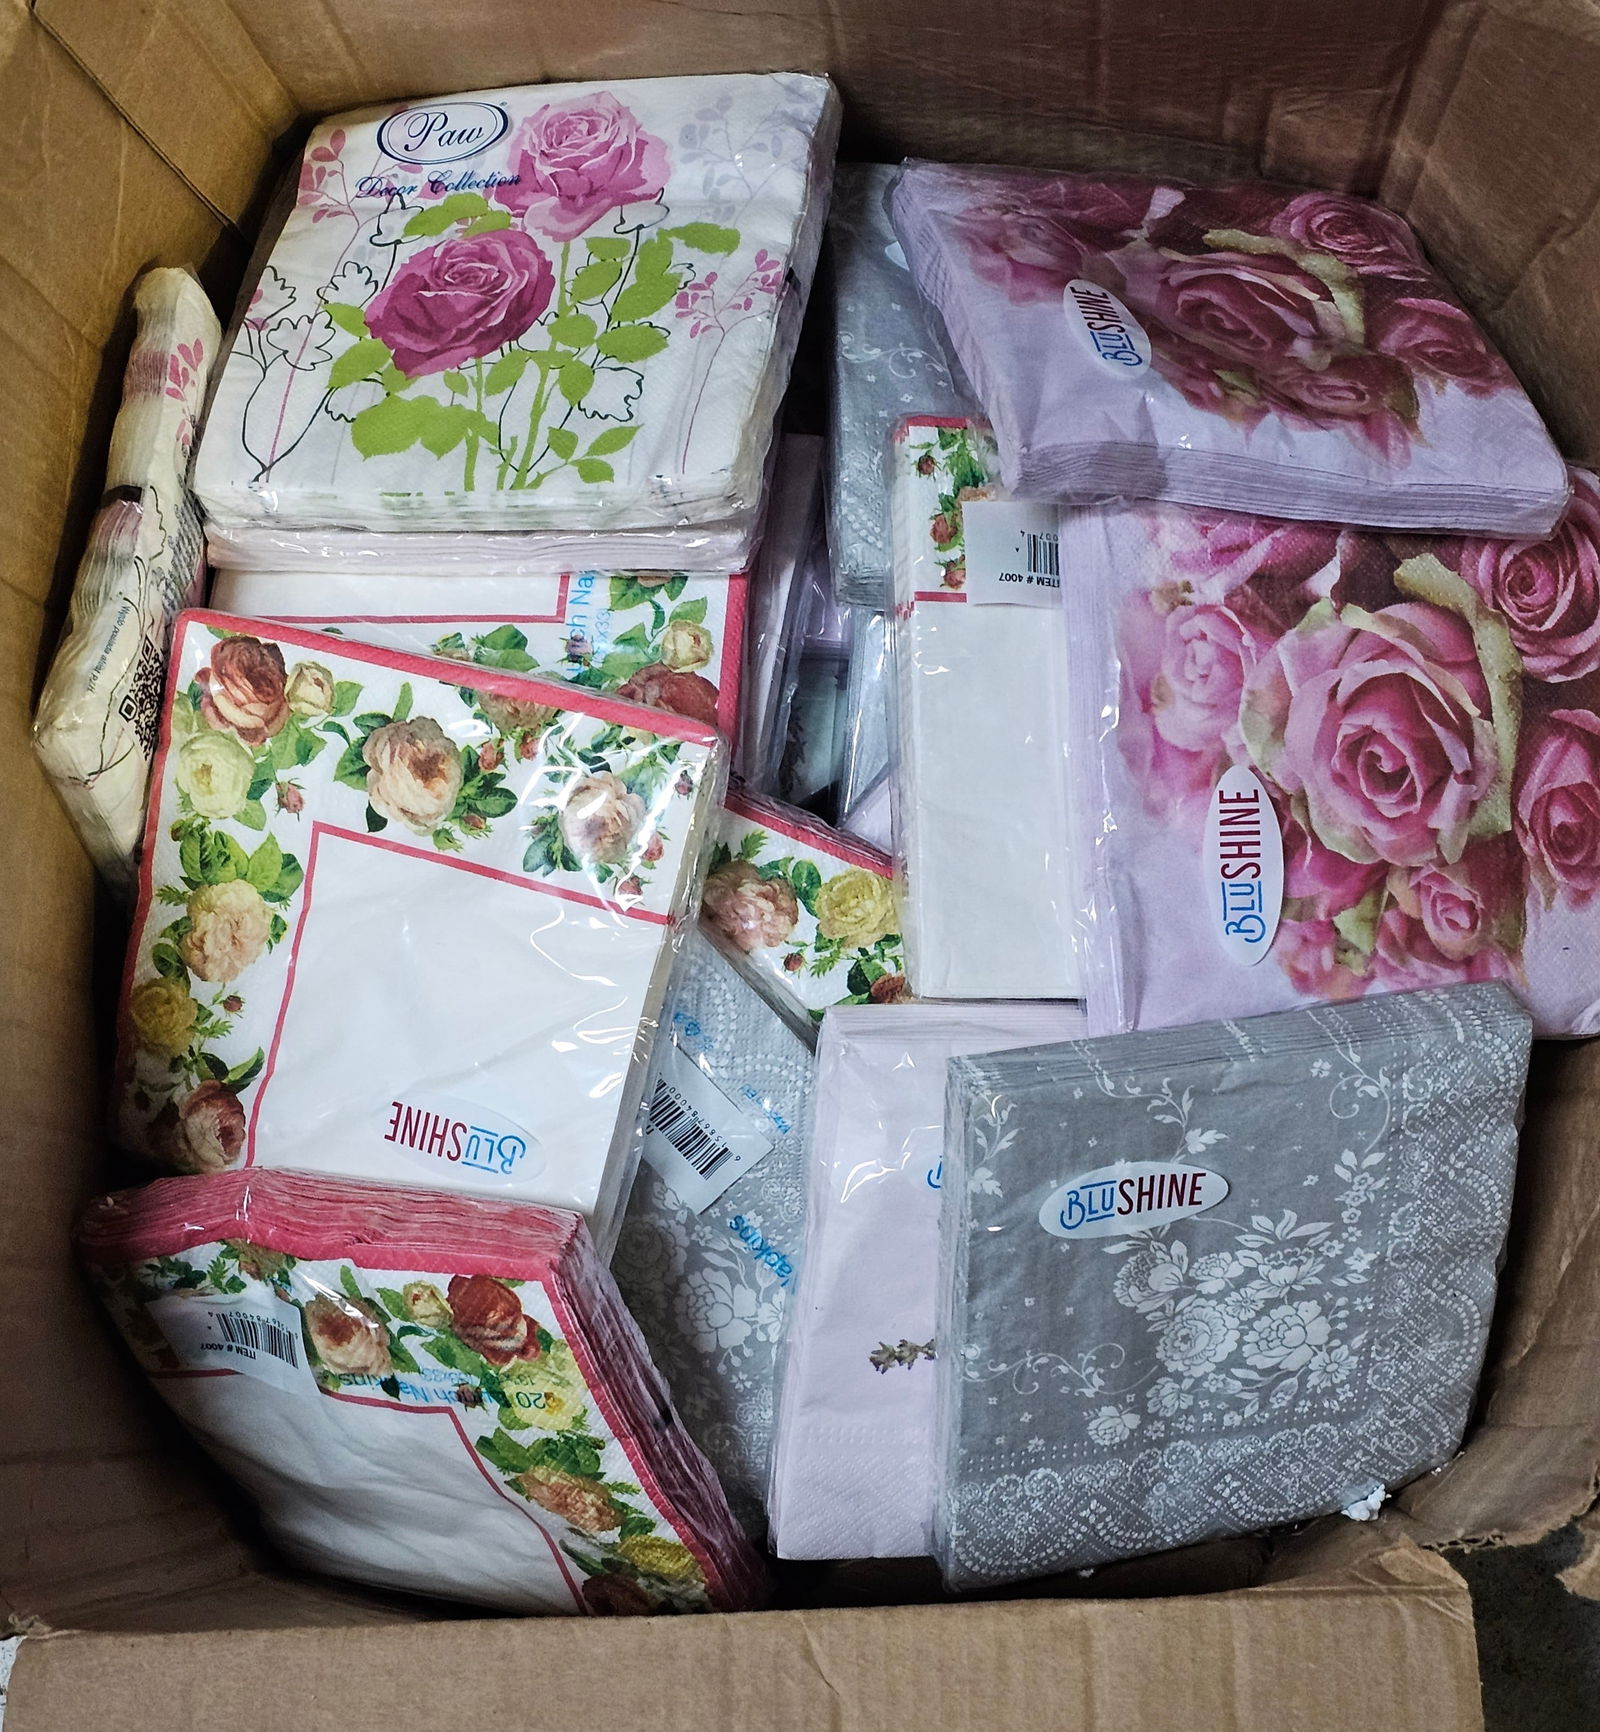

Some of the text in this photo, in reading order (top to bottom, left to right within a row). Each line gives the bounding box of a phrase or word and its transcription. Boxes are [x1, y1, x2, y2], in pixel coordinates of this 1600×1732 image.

[403, 111, 485, 152] Paw
[355, 169, 523, 199] Decor Collection
[998, 572, 1060, 588] ITEM # 4007
[729, 1215, 793, 1288] apkins
[200, 1343, 224, 1352] 4007
[235, 1346, 257, 1360] ITEM
[339, 1372, 430, 1404] Nakins
[515, 1390, 545, 1410] 20
